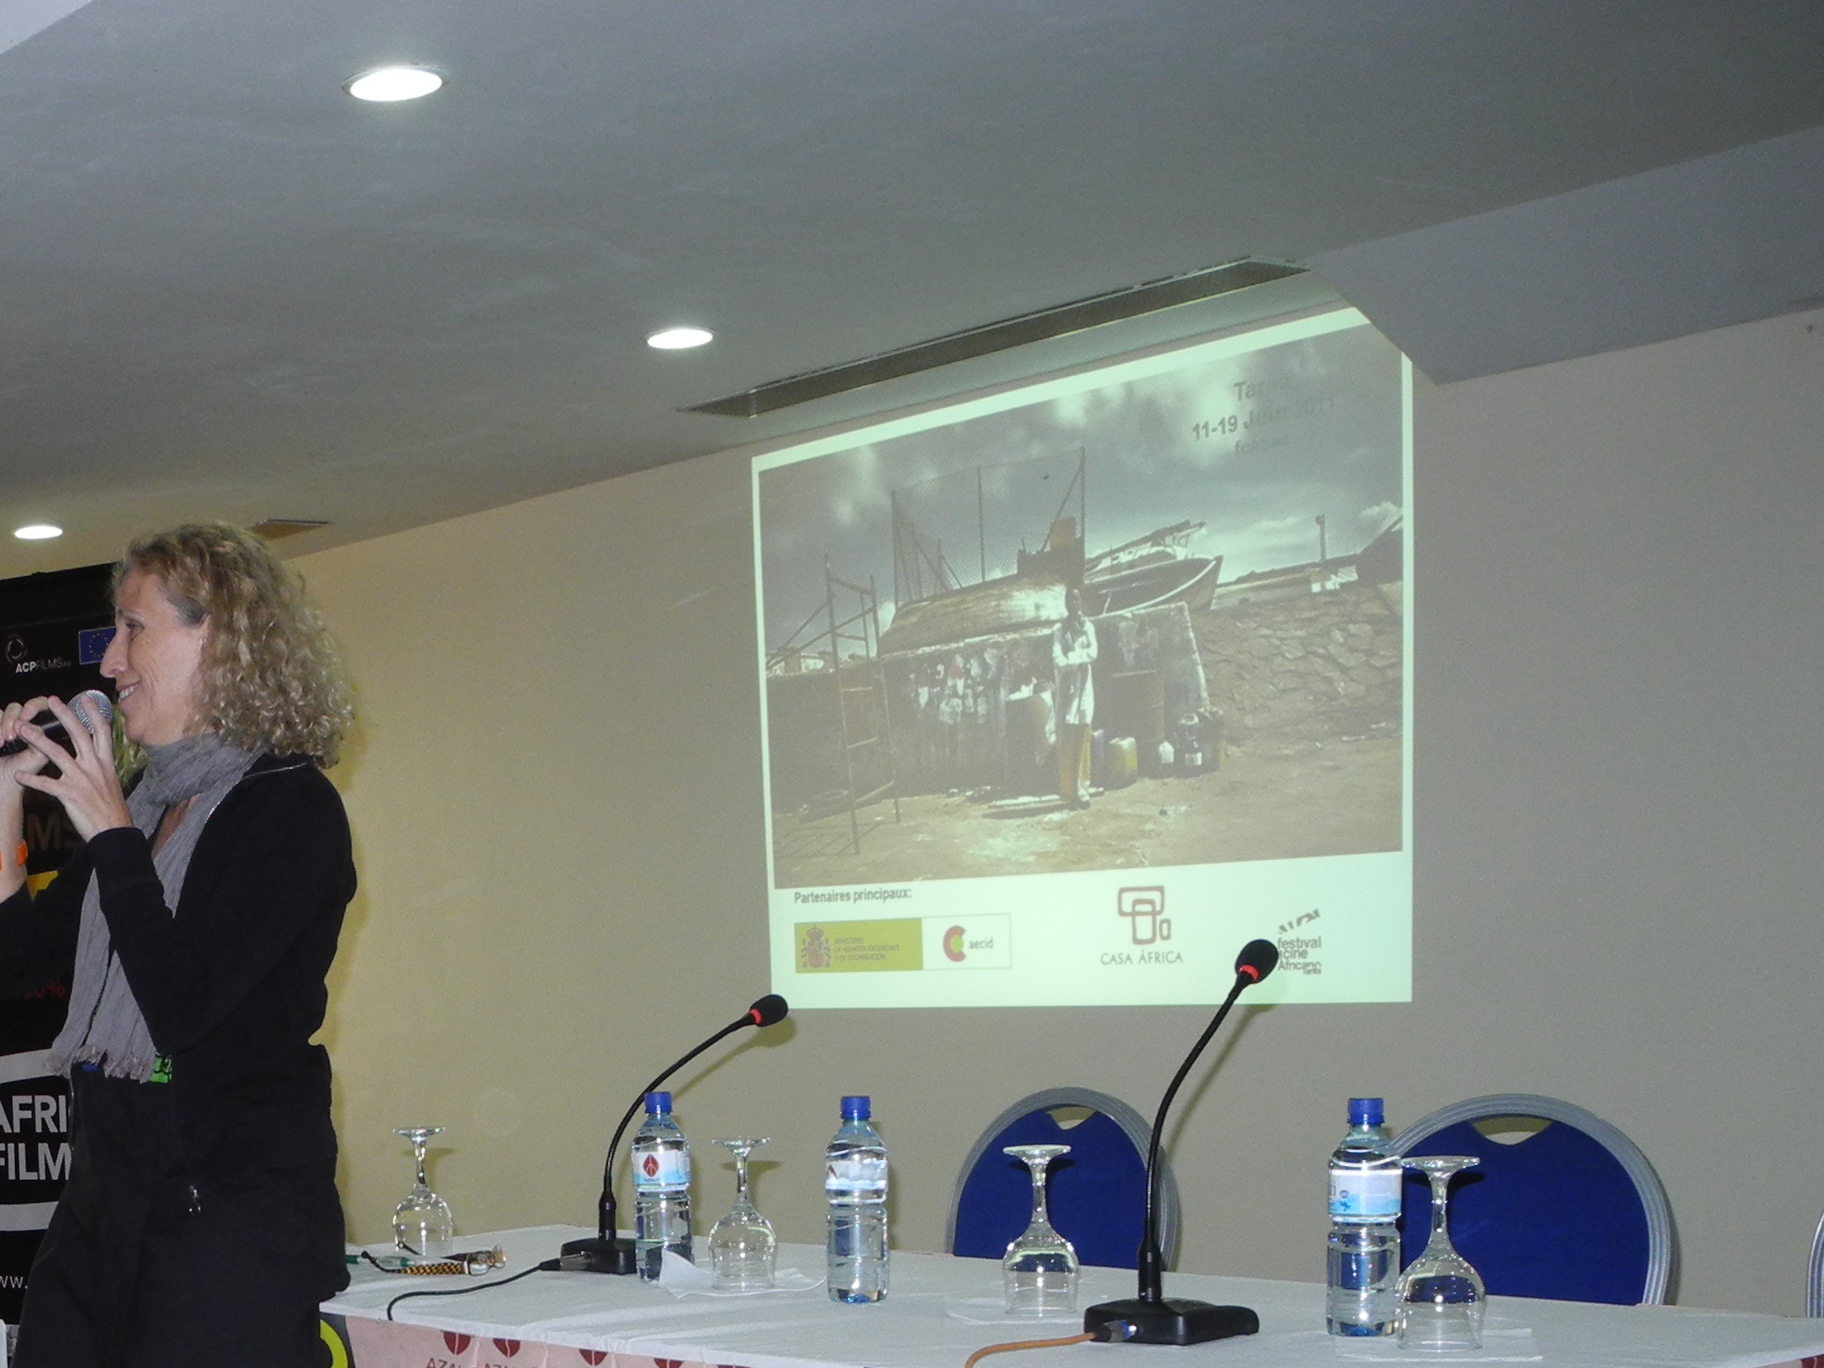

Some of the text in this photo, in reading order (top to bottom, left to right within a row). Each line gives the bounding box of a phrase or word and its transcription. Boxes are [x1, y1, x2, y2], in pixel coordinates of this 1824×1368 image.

[1191, 415, 1238, 441] 11-19
[794, 888, 912, 904] Partenaires principaux:
[969, 937, 994, 949] aecid
[1100, 948, 1184, 965] CASA ÁFRICA
